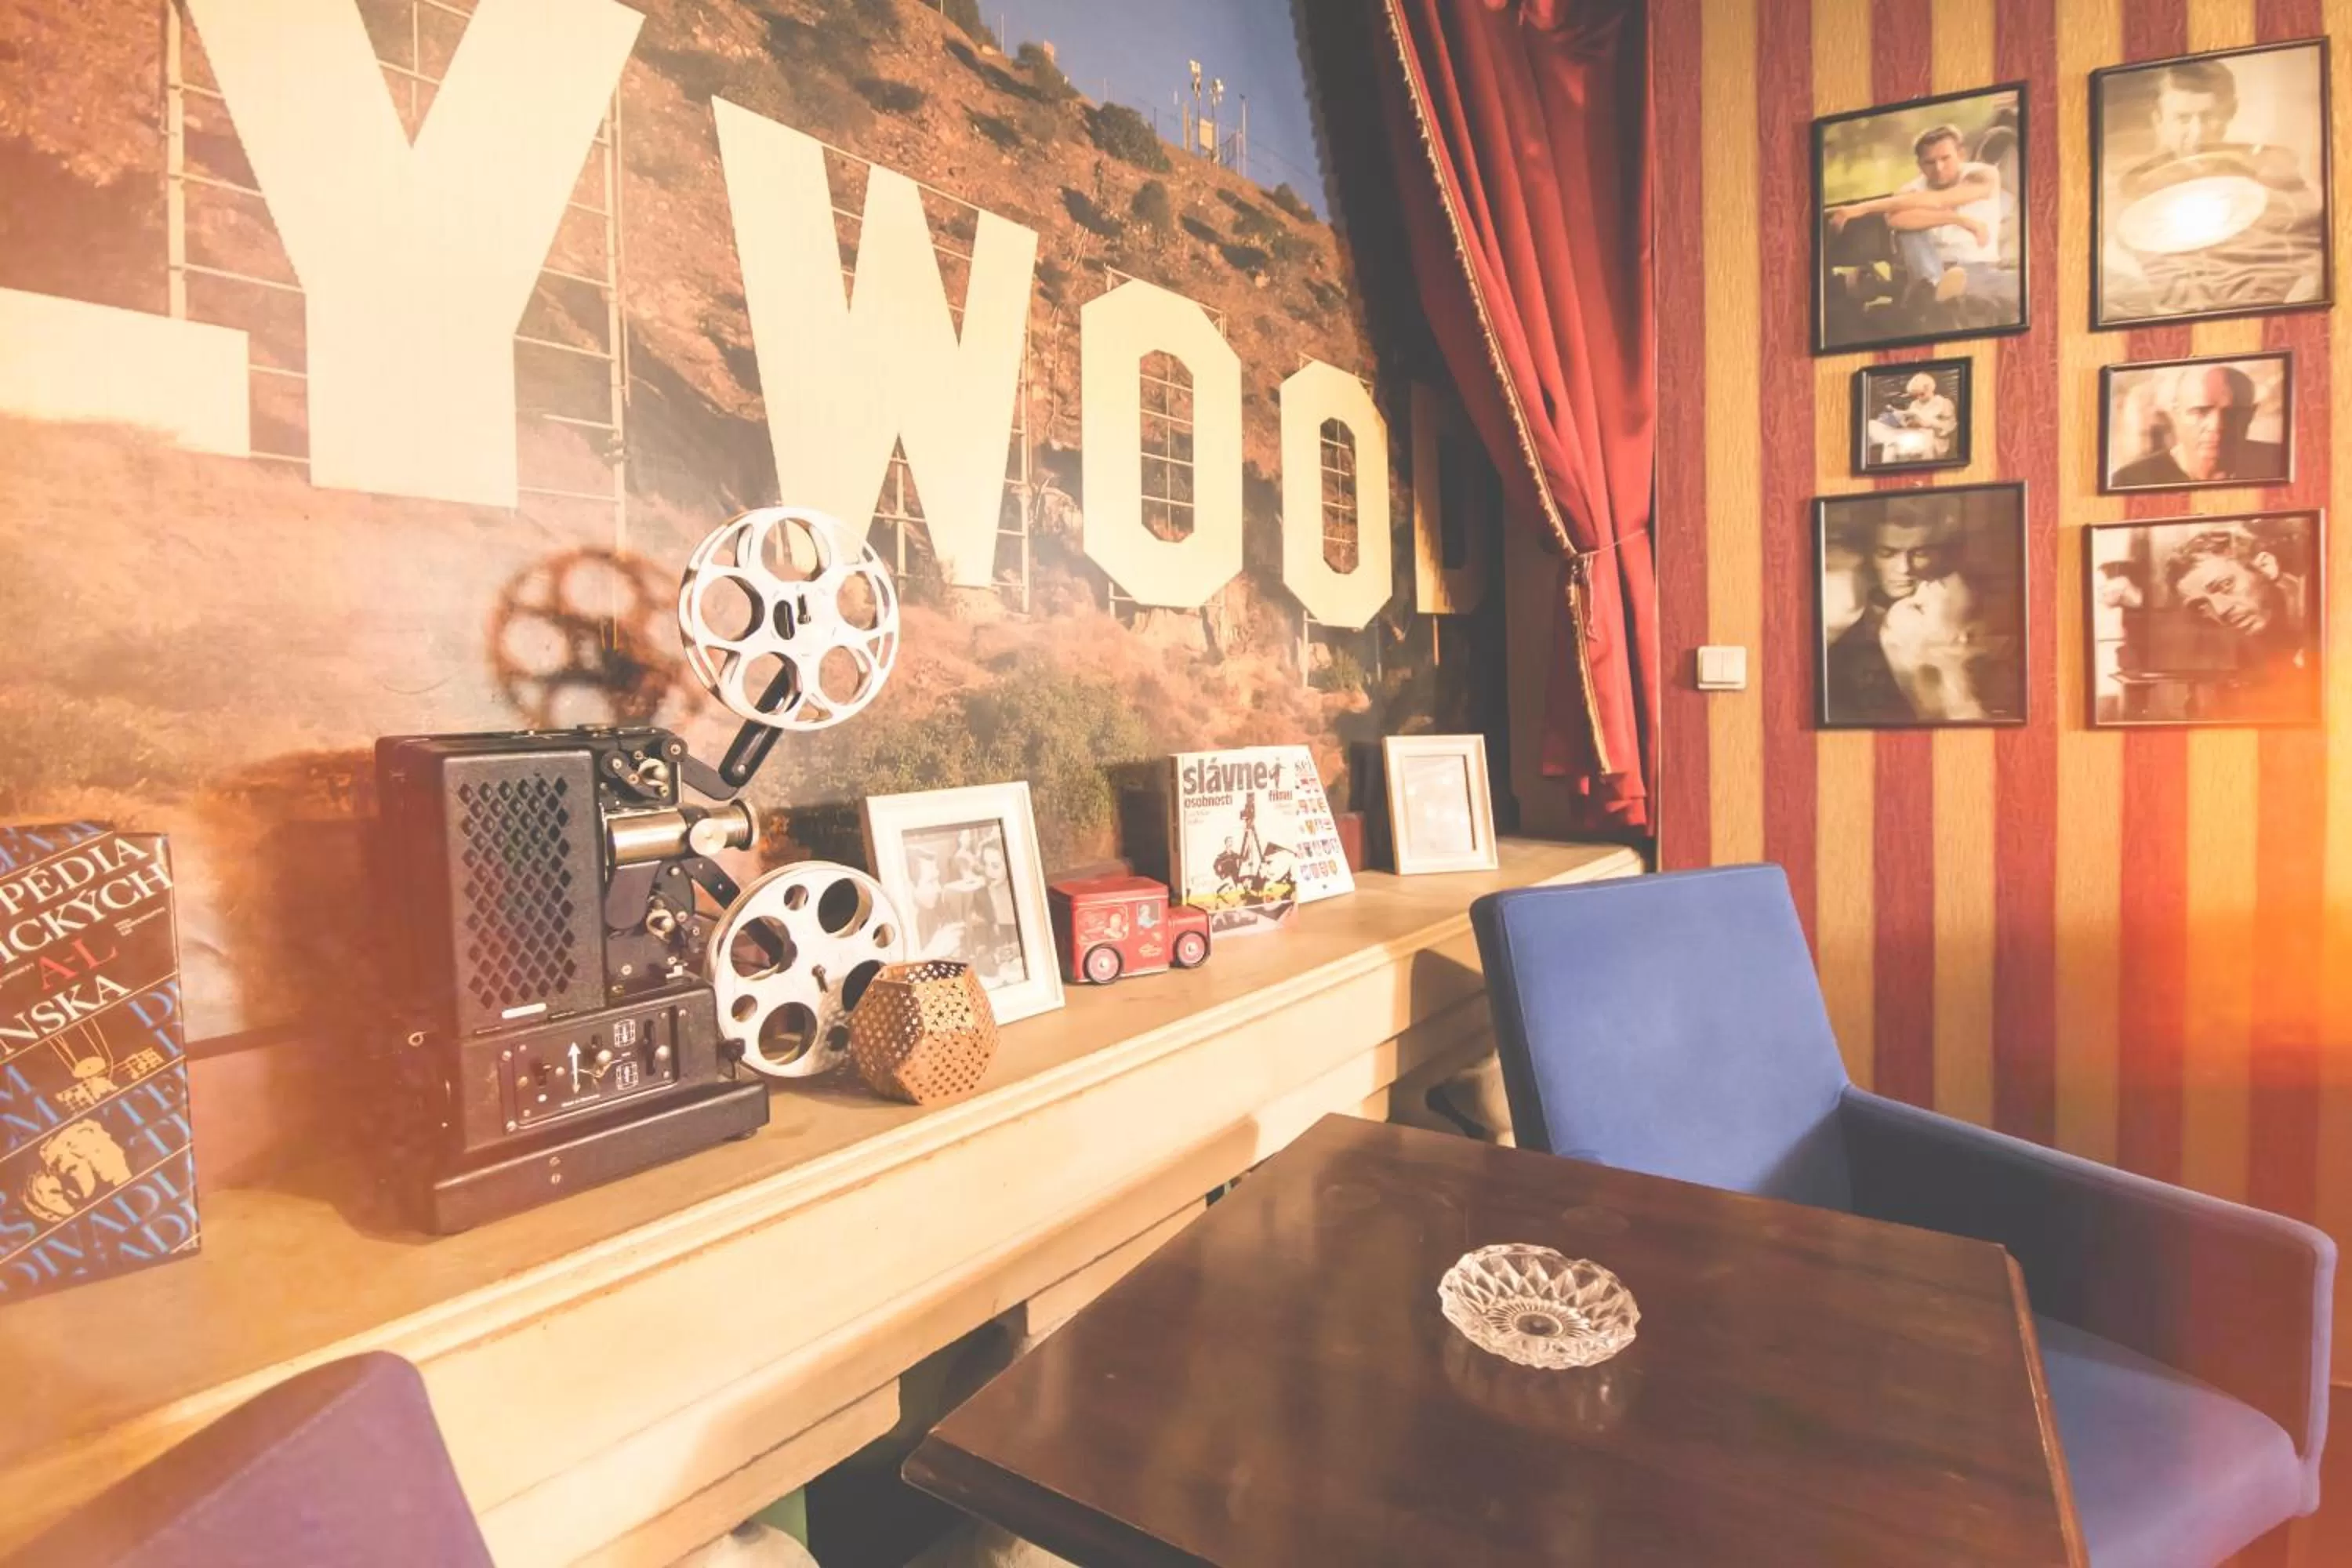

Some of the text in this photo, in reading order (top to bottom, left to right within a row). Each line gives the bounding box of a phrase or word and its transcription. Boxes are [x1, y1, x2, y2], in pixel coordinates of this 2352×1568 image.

[1183, 757, 1267, 795] slávne
[1185, 794, 1233, 809] osobnosti
[38, 937, 118, 991] A-L
